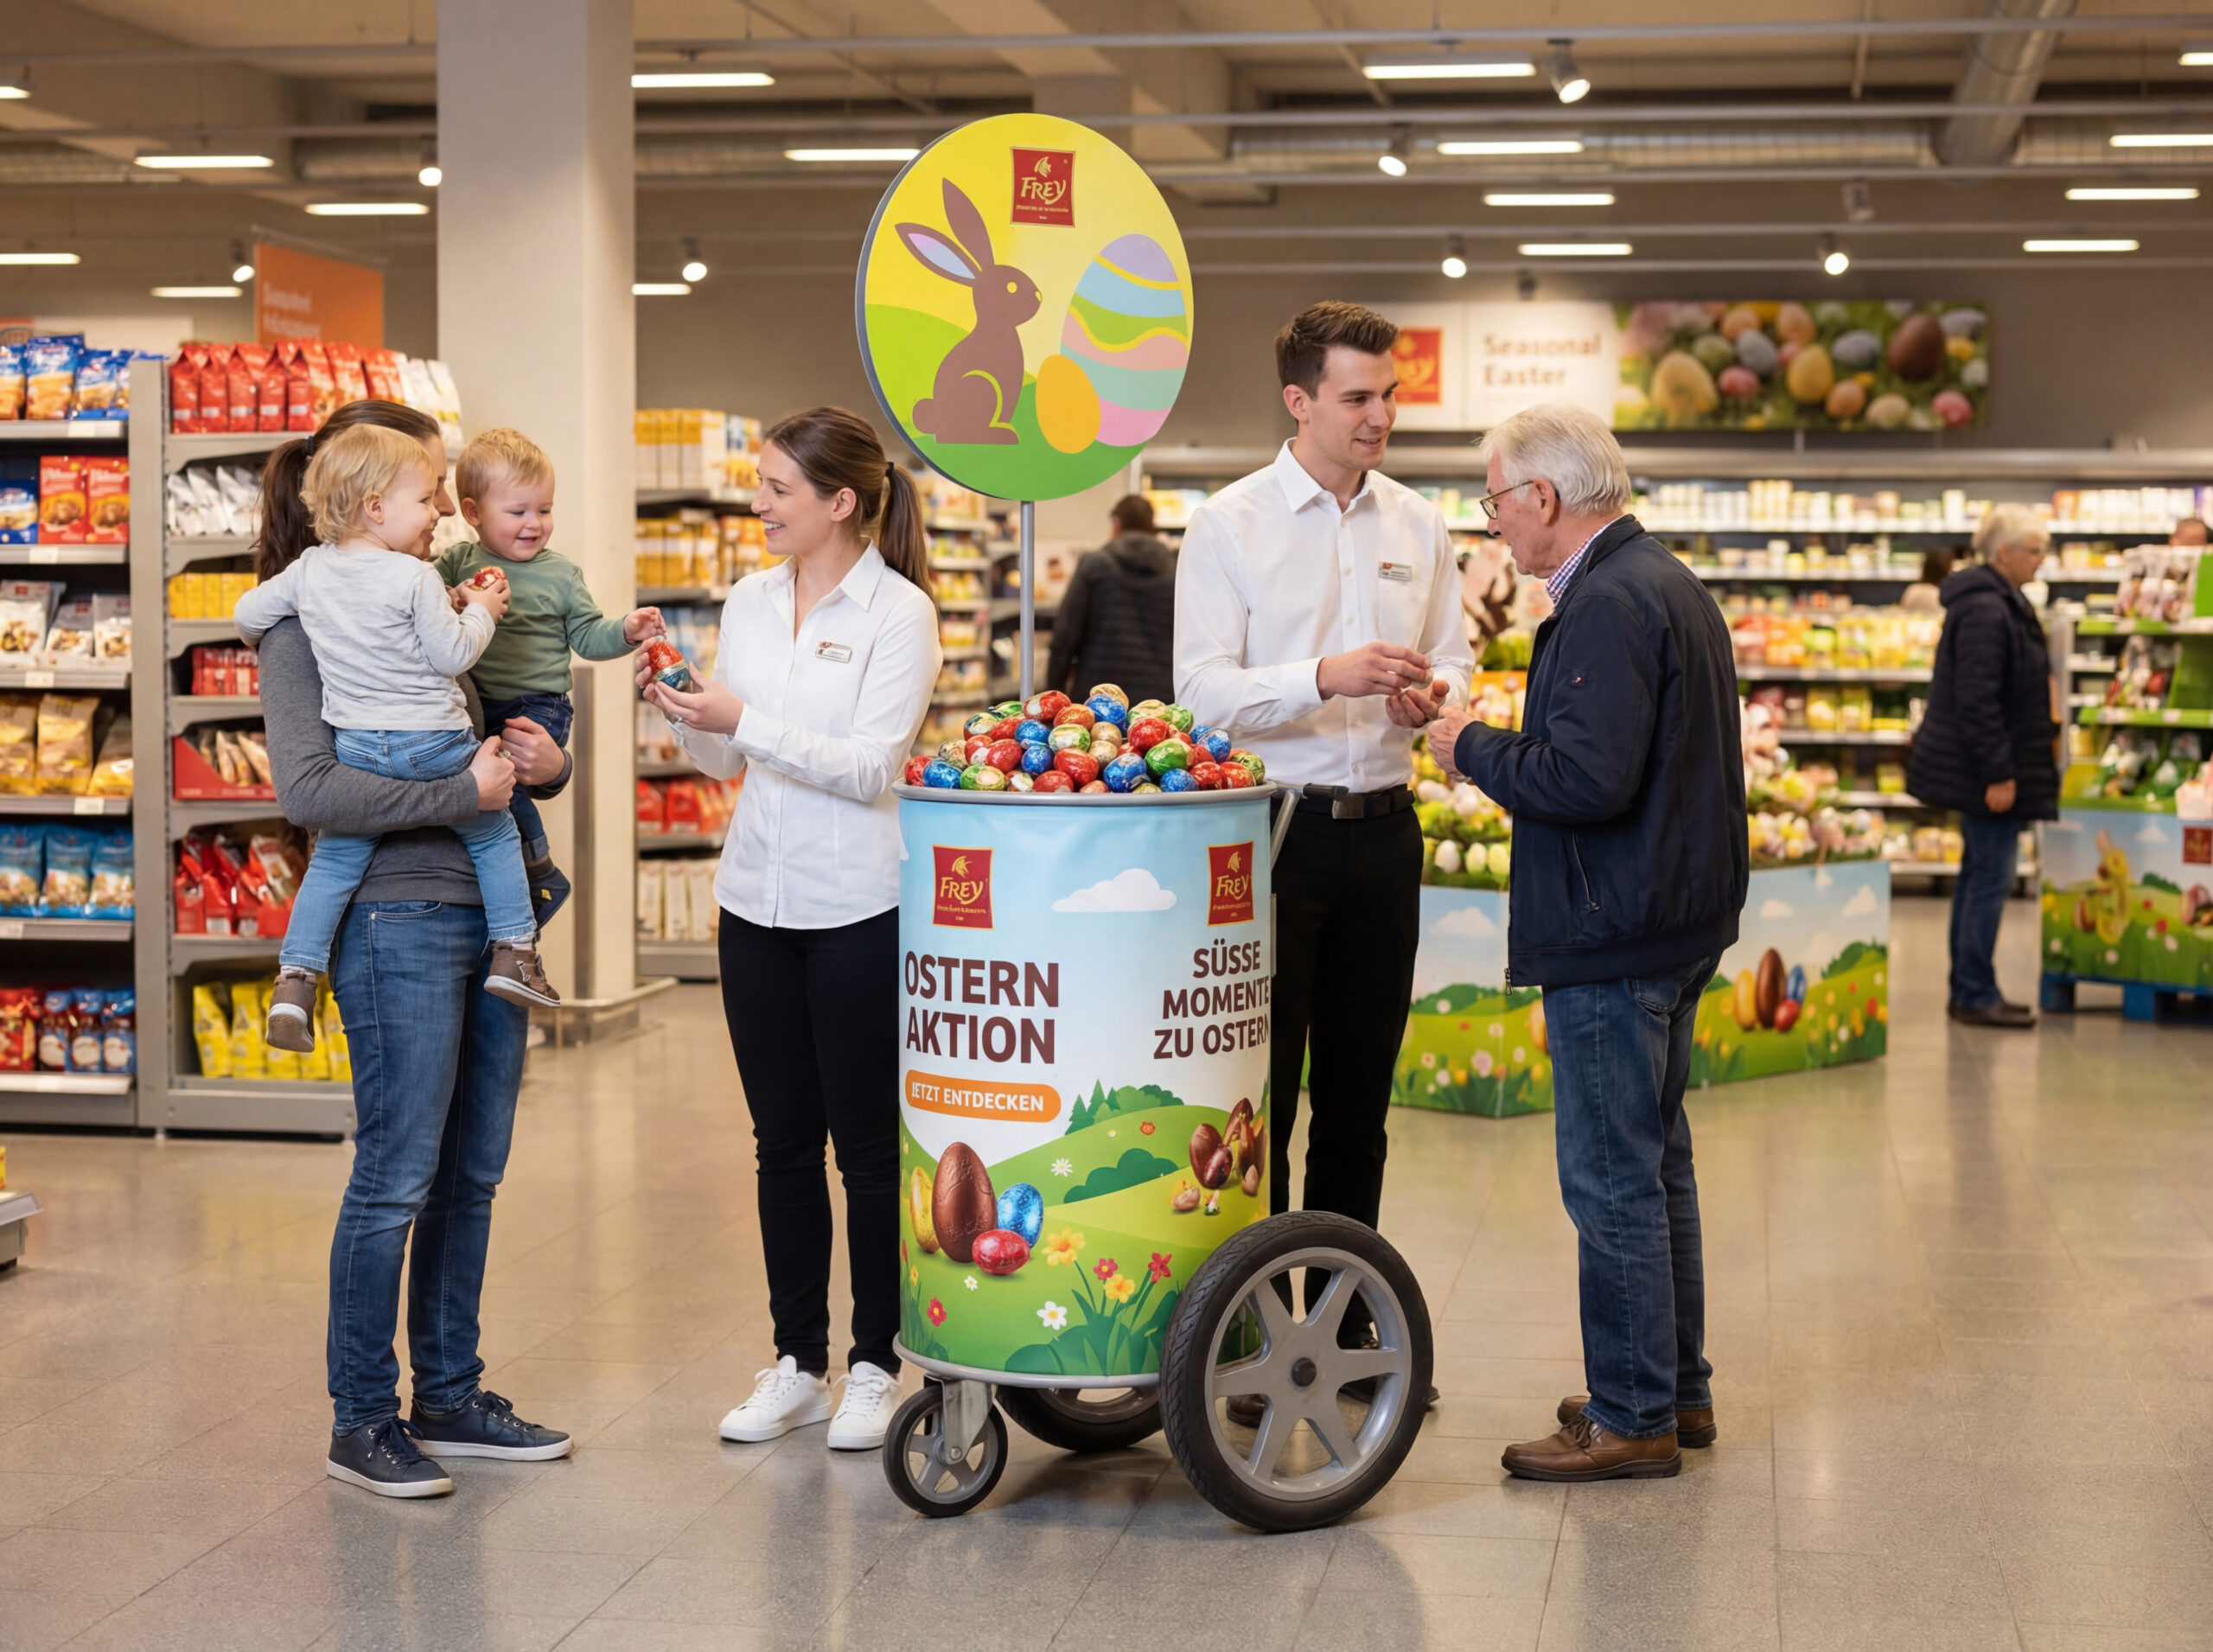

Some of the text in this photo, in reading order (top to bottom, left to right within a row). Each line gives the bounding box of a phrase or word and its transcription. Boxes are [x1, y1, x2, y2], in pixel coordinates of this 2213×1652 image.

[1483, 333, 1602, 357] Seasonal
[1484, 364, 1566, 386] Easter
[1192, 938, 1261, 979] SÜSSE
[904, 951, 1060, 1008] OSTERN
[1162, 975, 1270, 1020] MOMENTE
[905, 1006, 1055, 1065] AKTION
[1153, 1027, 1194, 1060] ZU
[911, 1081, 1044, 1113] JETZT ENTDECKEN
